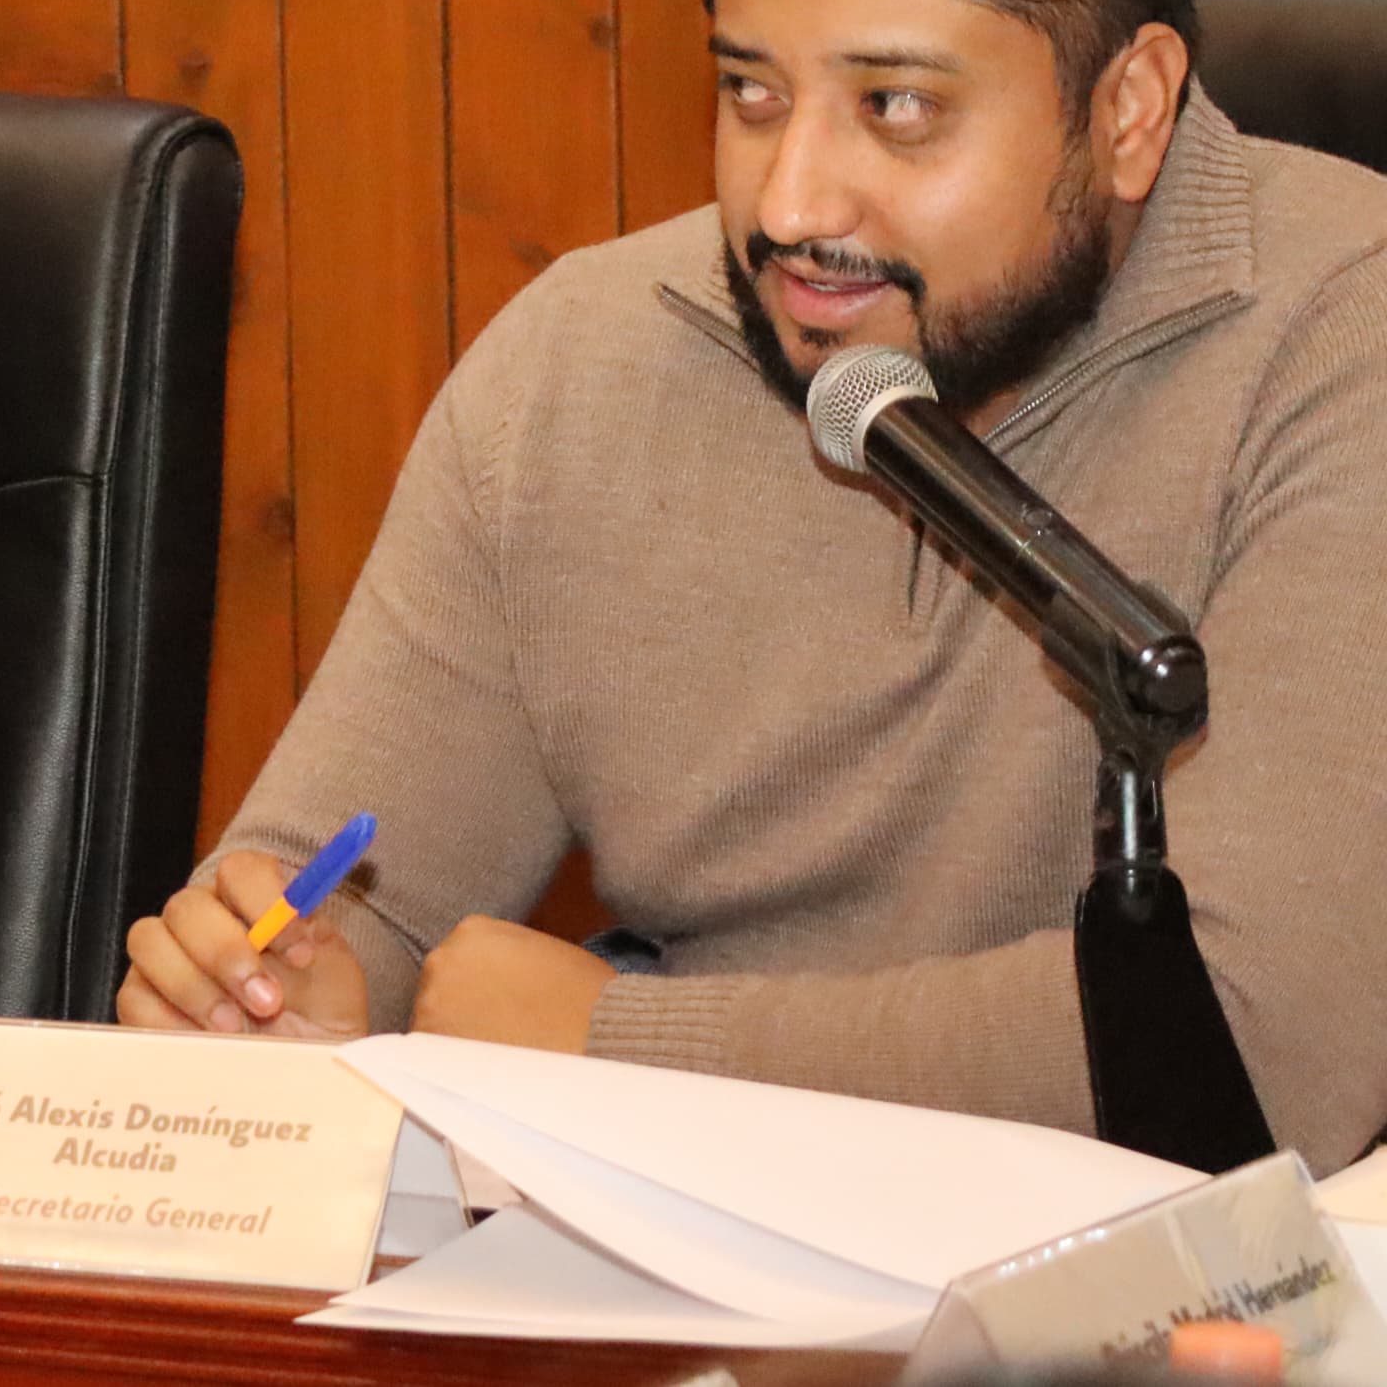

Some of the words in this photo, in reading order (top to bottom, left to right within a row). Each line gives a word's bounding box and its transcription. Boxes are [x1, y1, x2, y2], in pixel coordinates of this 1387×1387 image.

[9, 1094, 114, 1129] Alexis
[125, 1102, 313, 1148] Domínguez
[53, 1136, 177, 1173] Alcudia
[146, 1197, 273, 1235] General
